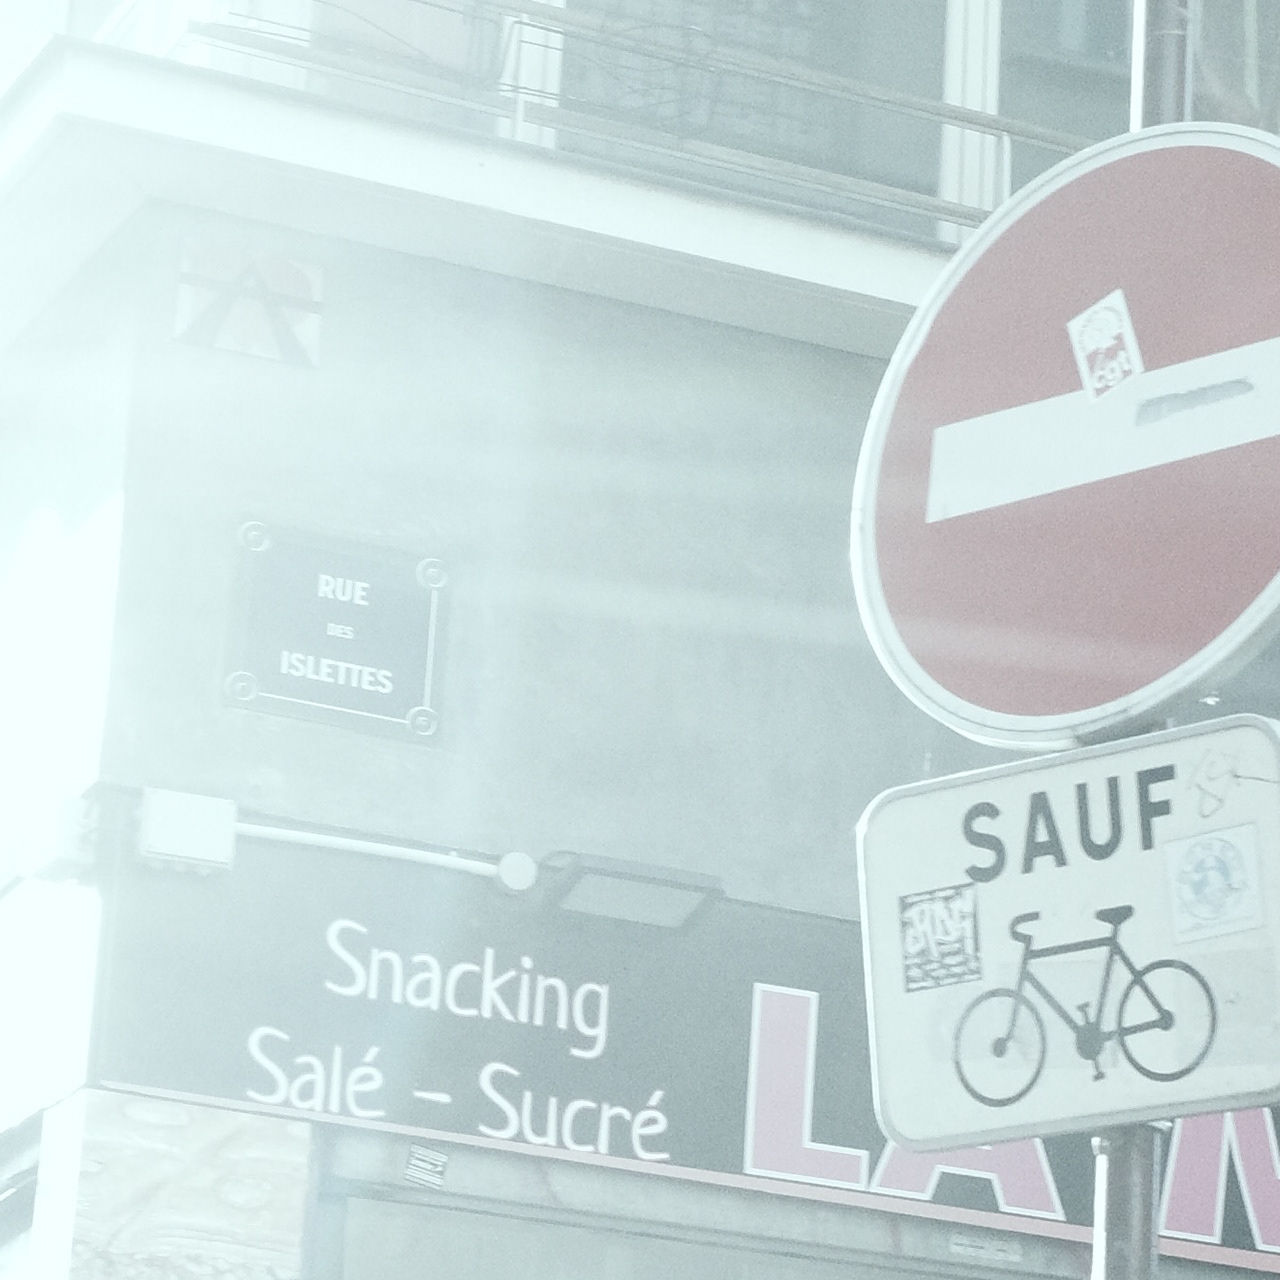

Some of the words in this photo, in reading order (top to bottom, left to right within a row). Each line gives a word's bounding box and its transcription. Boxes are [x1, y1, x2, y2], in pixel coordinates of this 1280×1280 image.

[317, 572, 371, 607] RUE
[326, 622, 355, 640] DES
[279, 648, 394, 697] ISLETTES
[961, 764, 1178, 883] SAUF
[324, 918, 611, 1060] Snacking
[245, 1026, 386, 1120] Salé
[477, 1061, 672, 1162] Sucré
